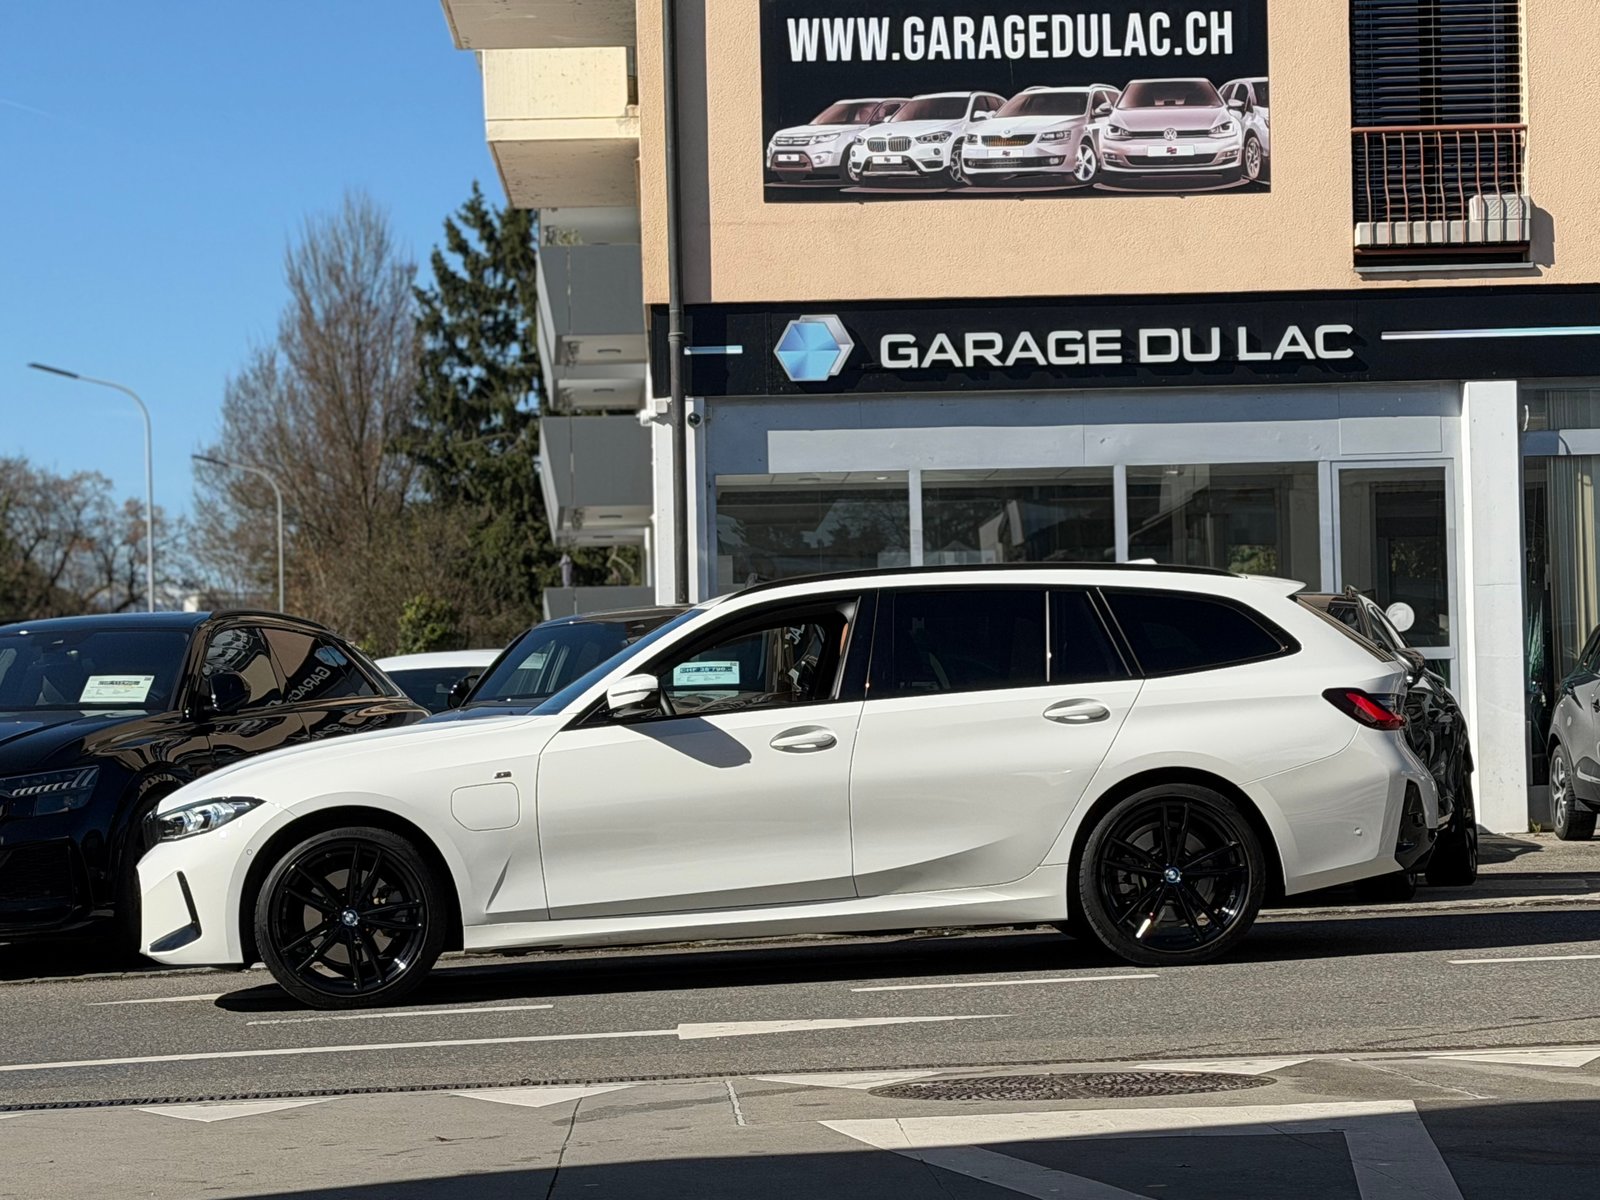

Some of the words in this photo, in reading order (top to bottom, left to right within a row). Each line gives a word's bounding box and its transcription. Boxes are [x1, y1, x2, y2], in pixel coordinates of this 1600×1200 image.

[787, 10, 1234, 63] WWW.GARAGEDULAC.CH
[879, 329, 1123, 369] GARAGE
[1138, 326, 1221, 364] DU
[1237, 323, 1355, 361] LAC
